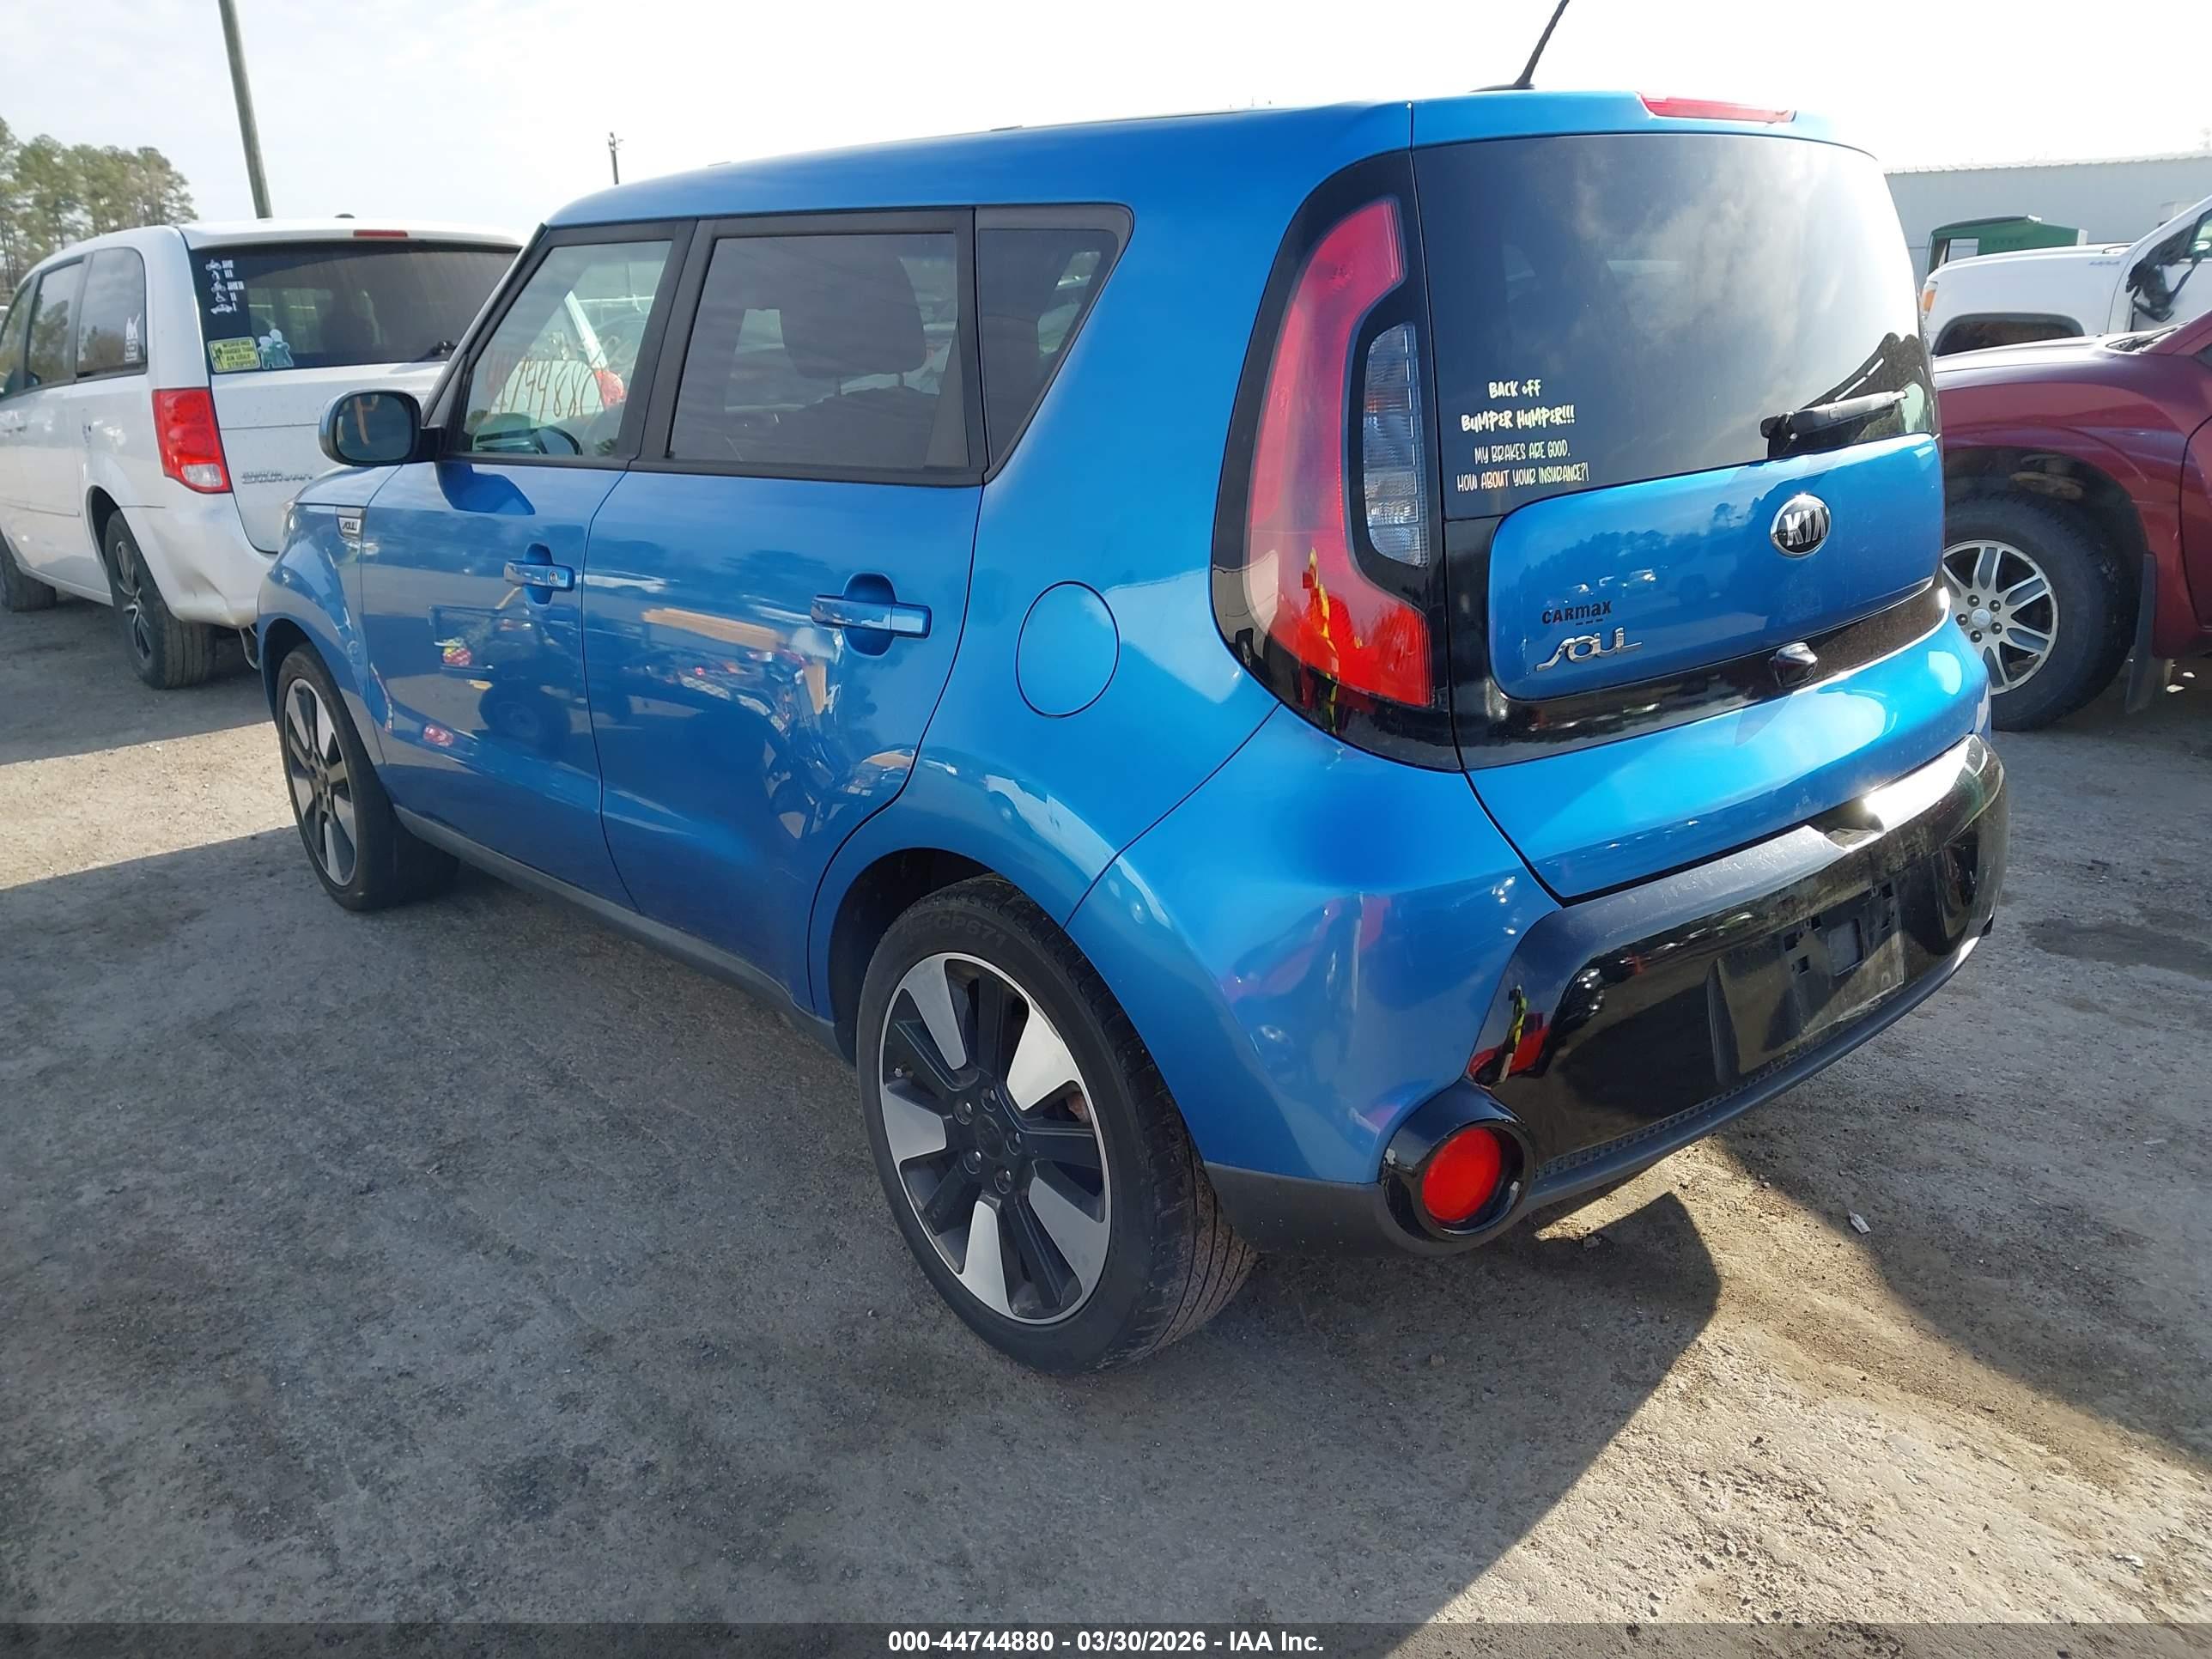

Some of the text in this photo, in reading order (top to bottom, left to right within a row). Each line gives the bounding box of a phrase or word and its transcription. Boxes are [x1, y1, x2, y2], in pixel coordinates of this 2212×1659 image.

[1488, 380, 1518, 399] BACK
[1474, 439, 1571, 465] MY BRAKES ARE GOOD.
[1456, 473, 1478, 492] HOW
[1480, 470, 1510, 489] ABOUT
[1512, 467, 1536, 487] YOUR
[1784, 507, 1826, 547] KIA
[1536, 627, 1642, 672] SOUL
